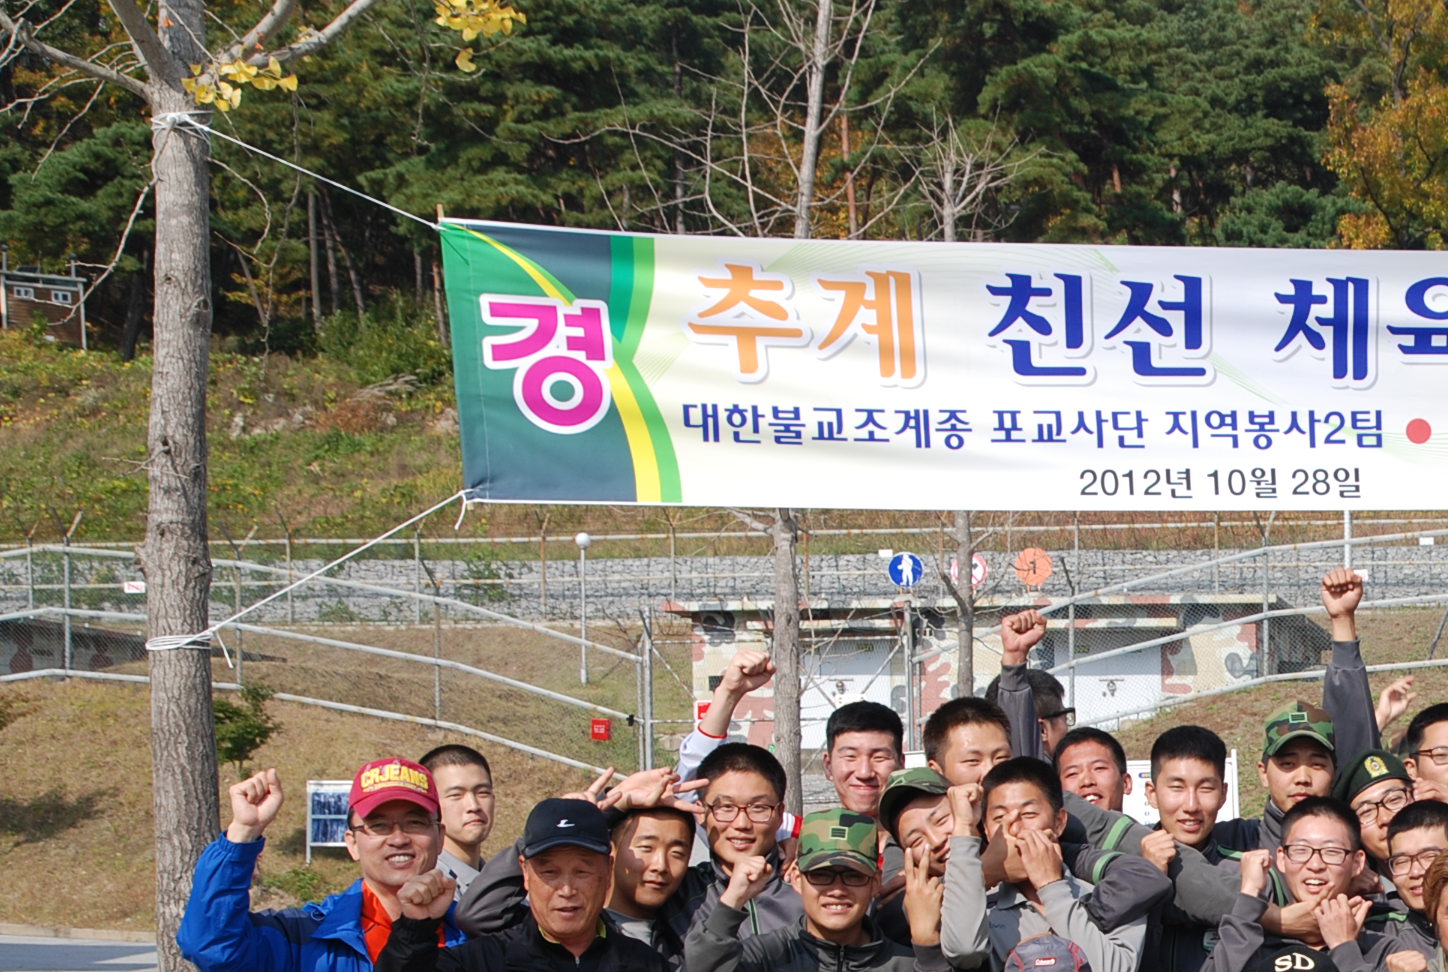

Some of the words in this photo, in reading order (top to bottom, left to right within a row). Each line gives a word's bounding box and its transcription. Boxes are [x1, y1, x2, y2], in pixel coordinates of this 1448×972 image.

[688, 263, 916, 377] 추계
[985, 272, 1208, 377] 친선
[482, 296, 611, 433] 경
[682, 403, 973, 450] 대한불교조계종
[990, 409, 1149, 449] 포교사단
[1165, 409, 1383, 450] 지역봉사2팀
[1079, 467, 1193, 499] 2012년
[1207, 466, 1277, 499] 10월
[1291, 466, 1361, 499] 28일
[360, 763, 429, 790] CRJEANS
[1274, 952, 1315, 972] SD
